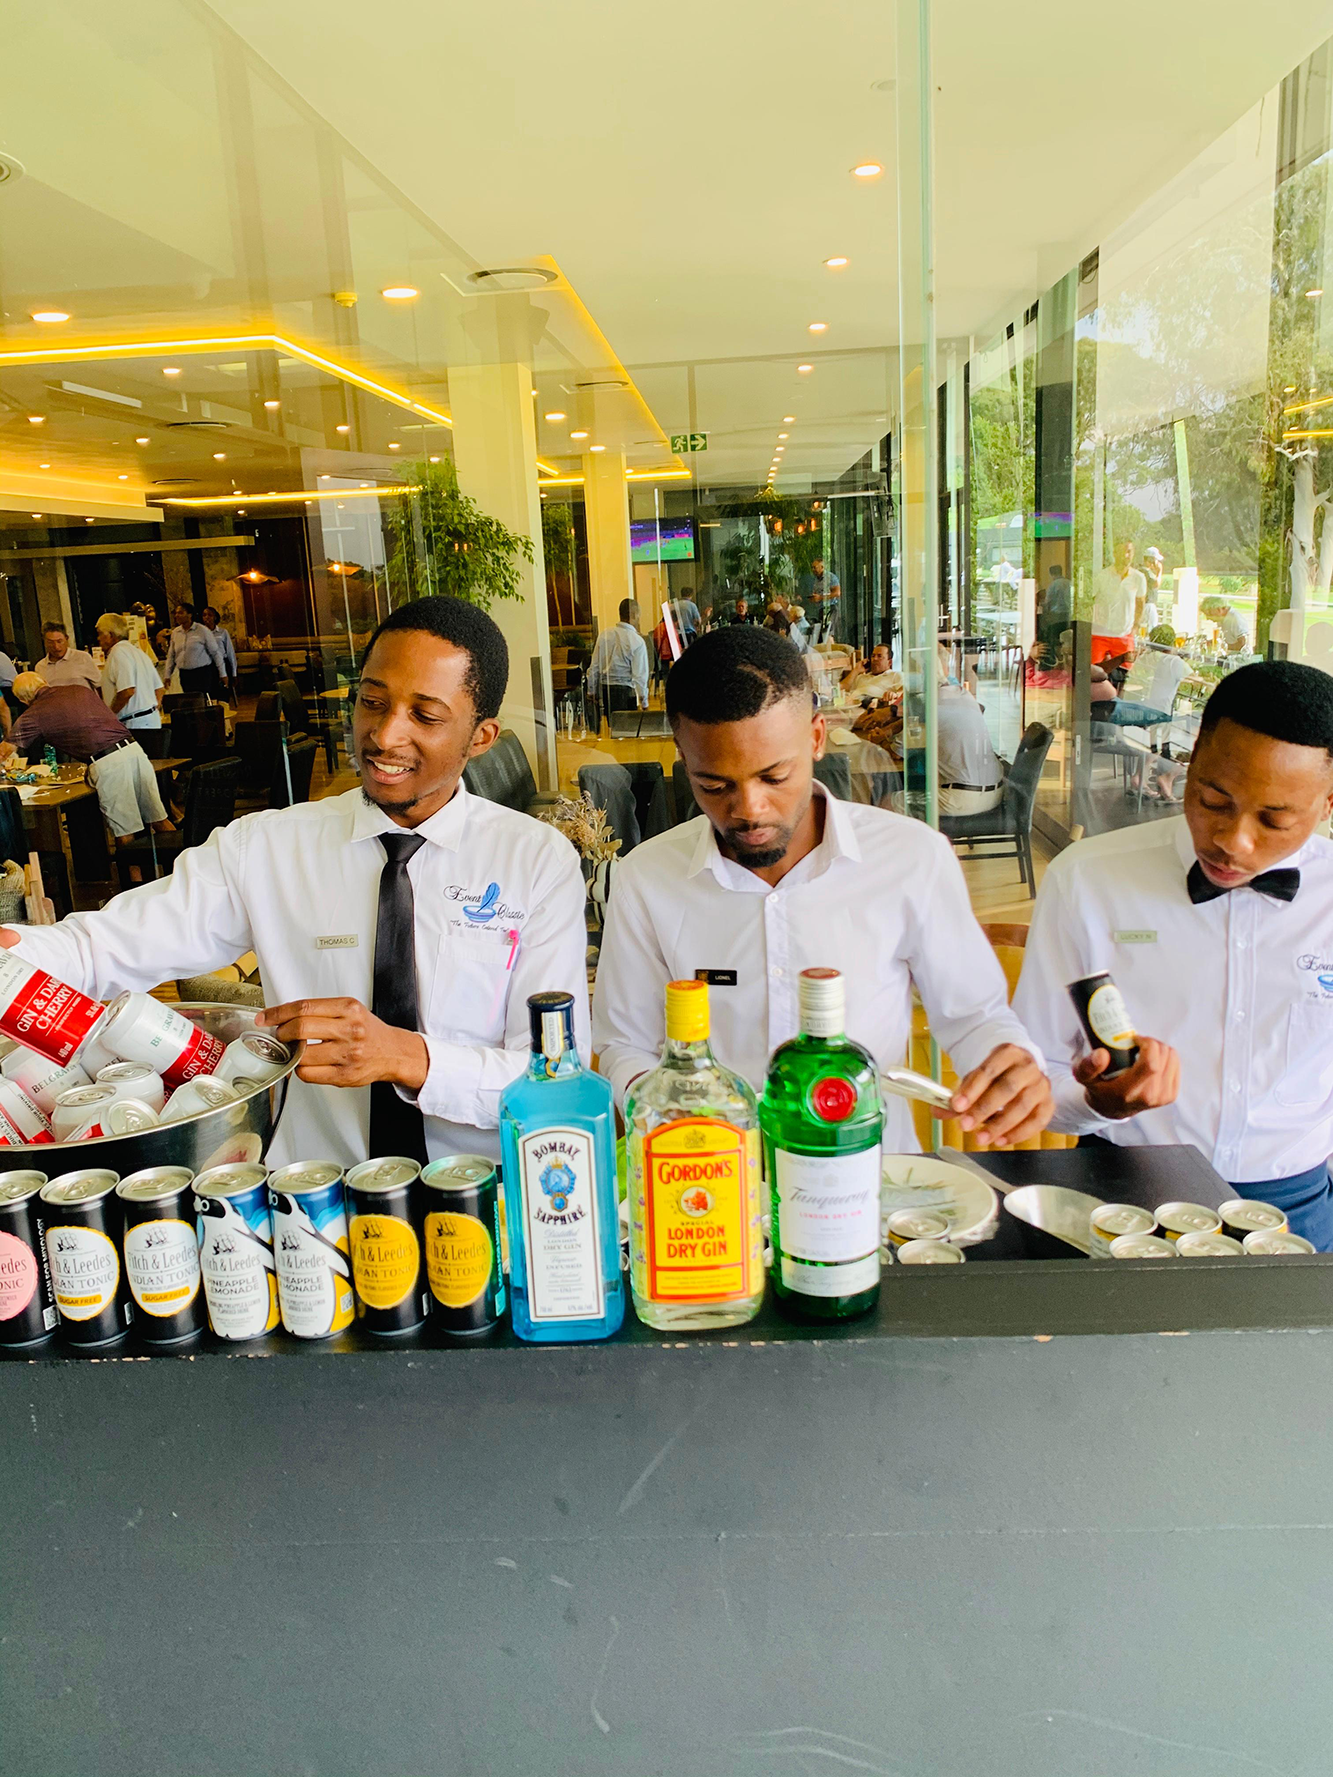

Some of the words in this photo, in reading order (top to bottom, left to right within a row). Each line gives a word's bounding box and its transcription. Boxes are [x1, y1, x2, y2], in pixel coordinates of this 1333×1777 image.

[319, 937, 349, 946] THOMAS
[16, 1008, 35, 1033] GIN
[32, 998, 48, 1010] &
[35, 985, 73, 1030] CHERRY
[182, 1058, 202, 1080] GIN
[195, 1048, 208, 1059] &
[532, 1141, 580, 1162] BOMBAY
[788, 1185, 870, 1209] Tanqueray
[533, 1205, 586, 1225] SAPPHIRE
[667, 1225, 725, 1240] LONDON
[151, 1254, 160, 1270] &
[162, 1245, 197, 1269] Leedes
[367, 1246, 375, 1262] &
[378, 1243, 413, 1262] Leedes
[441, 1244, 449, 1260] &
[451, 1242, 487, 1261] Leedes
[666, 1242, 699, 1259] DRY
[701, 1240, 729, 1258] GIN
[0, 1257, 27, 1275] edes
[63, 1258, 71, 1275] &
[72, 1253, 112, 1275] Leedes
[220, 1258, 227, 1272] &
[229, 1254, 261, 1272] Leedes
[294, 1253, 326, 1269] Leedes
[76, 1270, 115, 1289] TONIC
[80, 1296, 98, 1305] FREE
